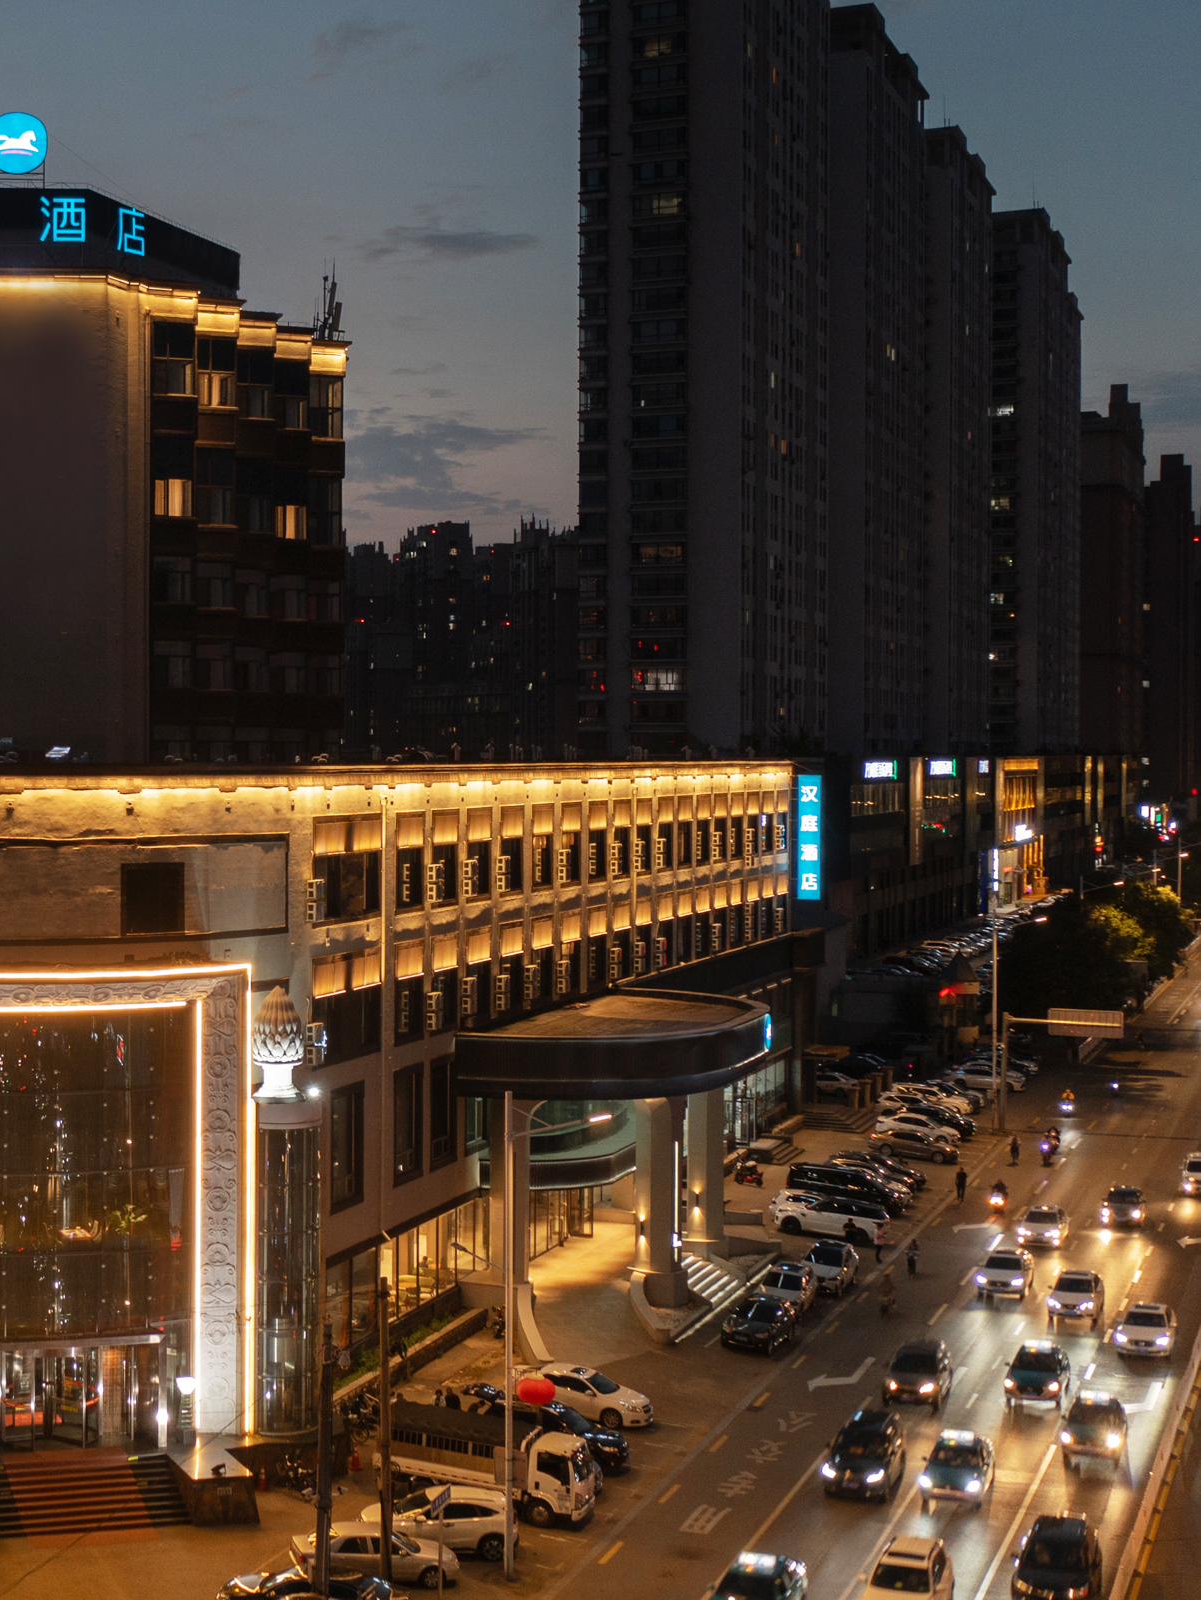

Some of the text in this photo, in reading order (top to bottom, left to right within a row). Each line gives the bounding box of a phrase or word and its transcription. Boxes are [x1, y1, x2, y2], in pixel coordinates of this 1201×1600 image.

[800, 785, 819, 891] 汉庭酒店
[679, 1410, 817, 1534] 公交专用
